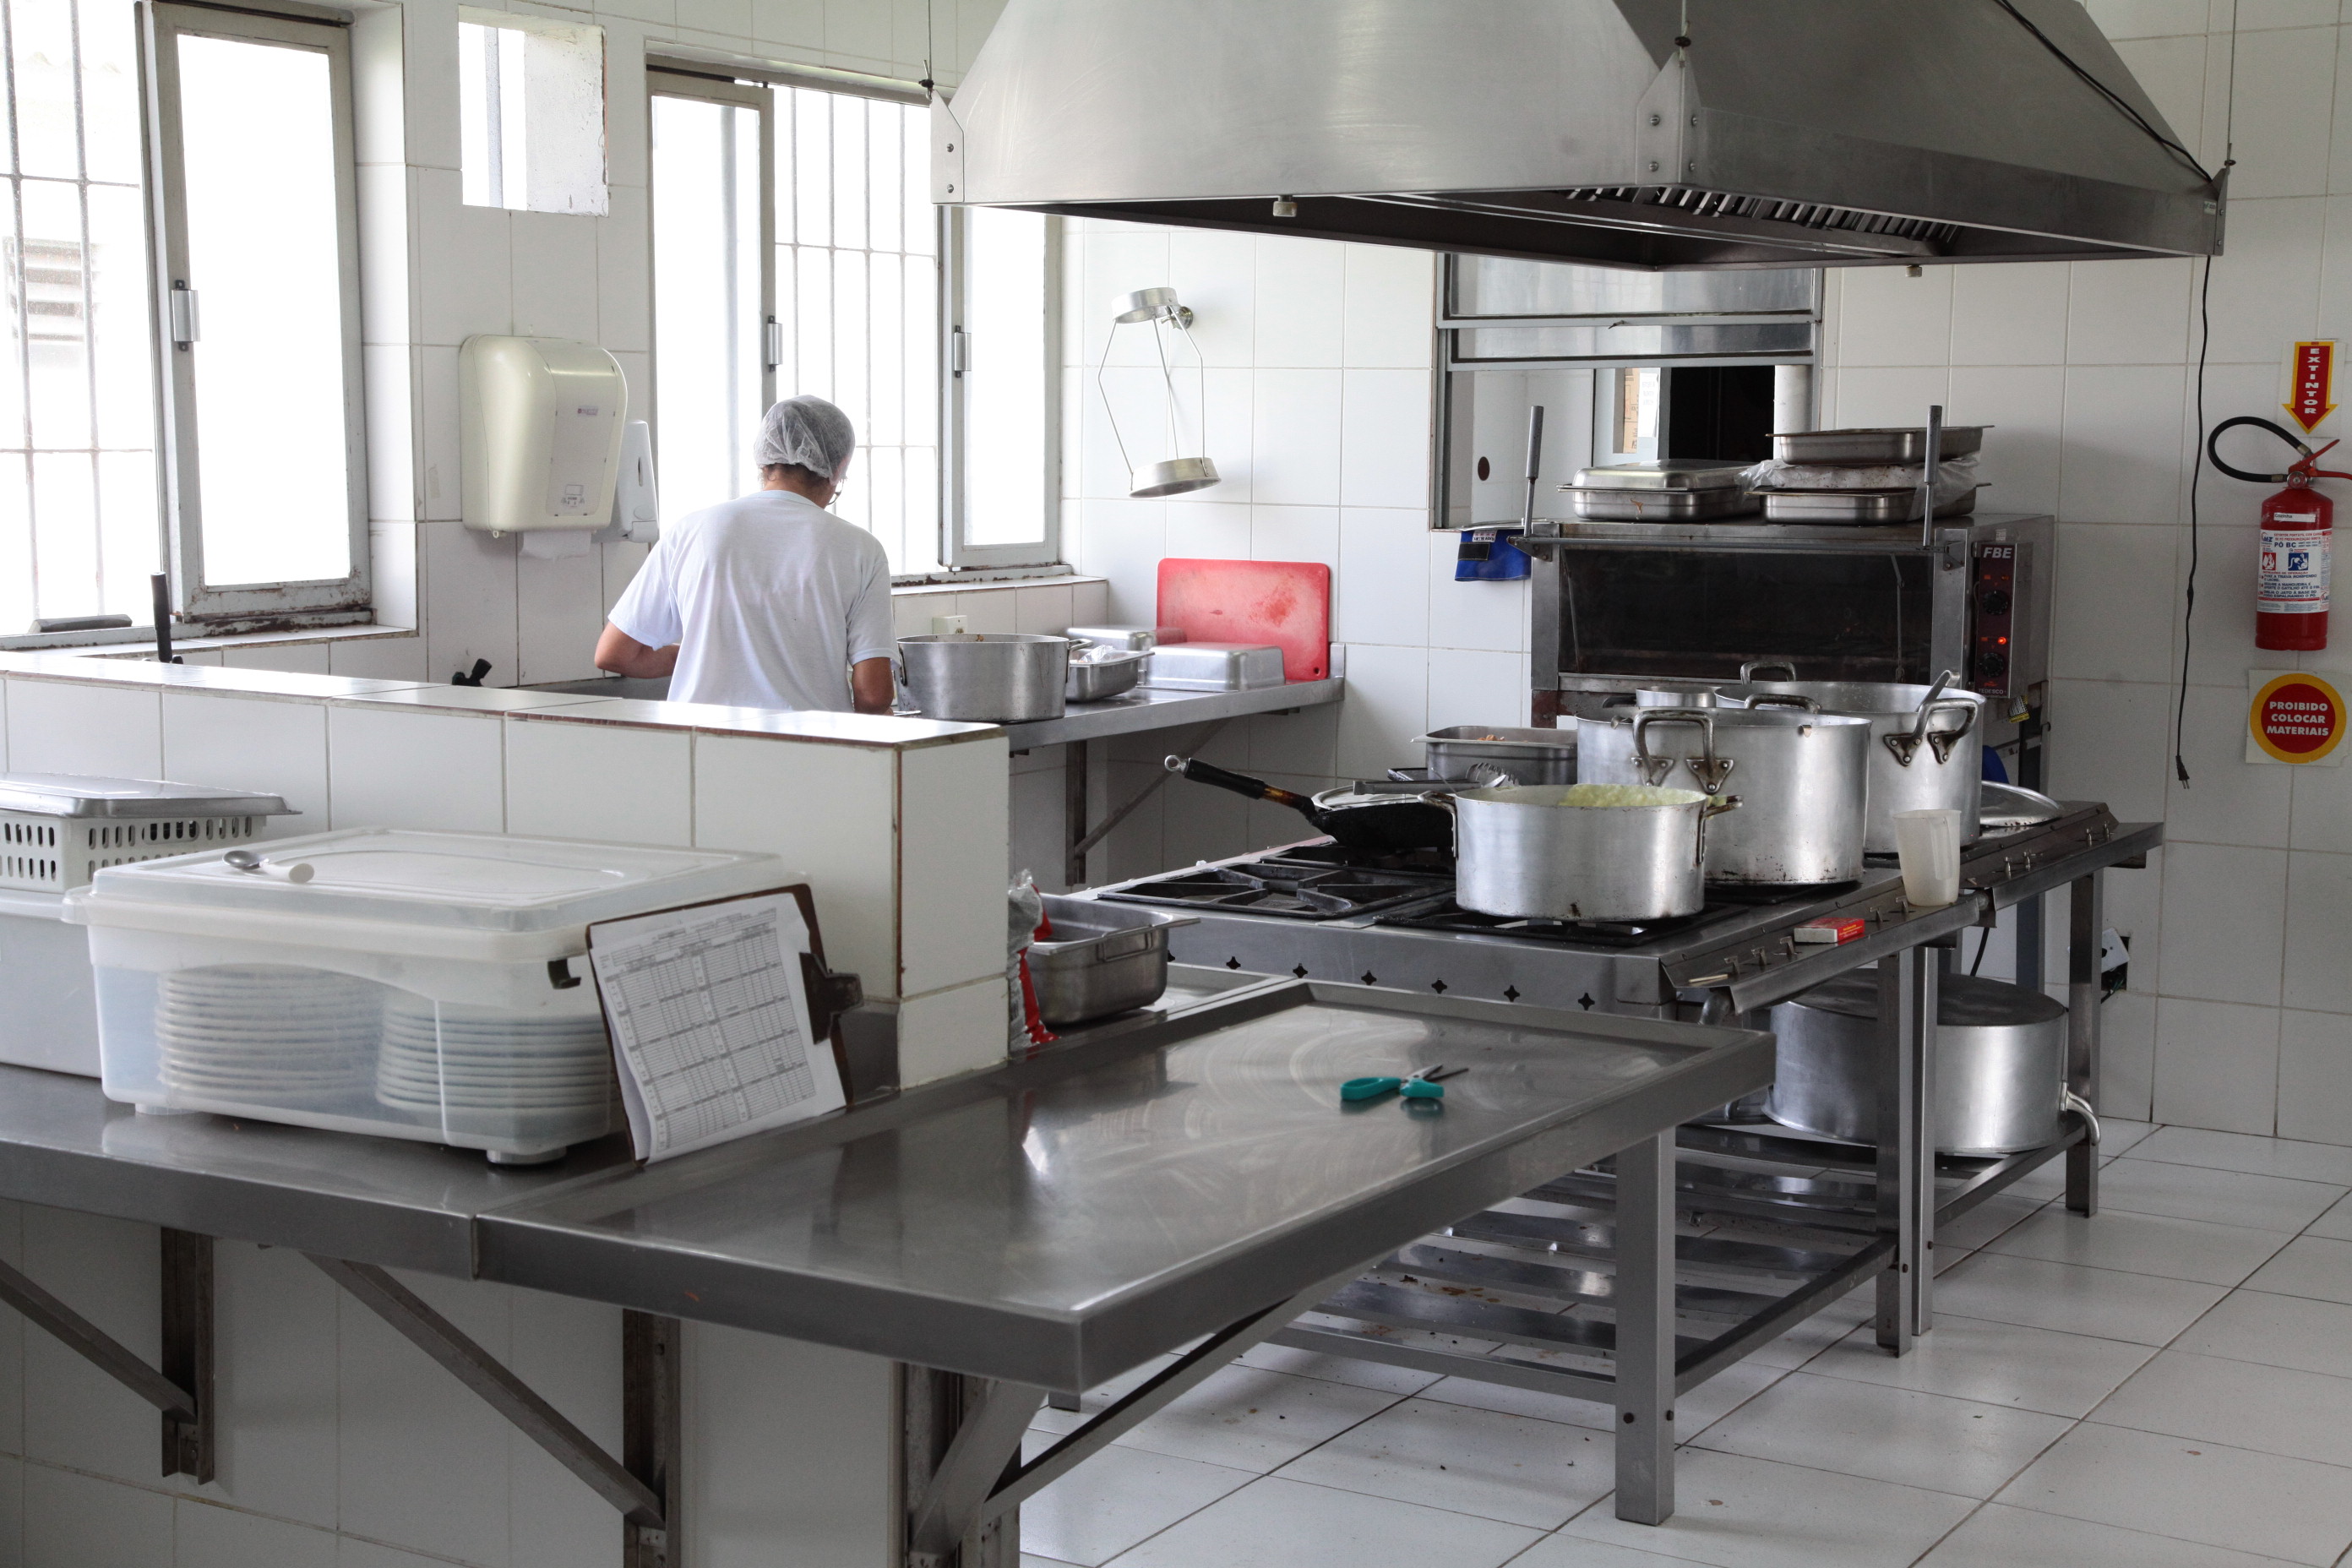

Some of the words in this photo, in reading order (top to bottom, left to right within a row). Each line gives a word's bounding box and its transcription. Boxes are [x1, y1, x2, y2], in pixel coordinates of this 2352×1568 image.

[2304, 348, 2321, 414] EXTINTOR
[1983, 547, 2012, 559] FBE
[2269, 701, 2328, 711] PROIBIDO
[2271, 714, 2326, 723] COLOCAR
[2267, 726, 2329, 736] MATERIAIS
